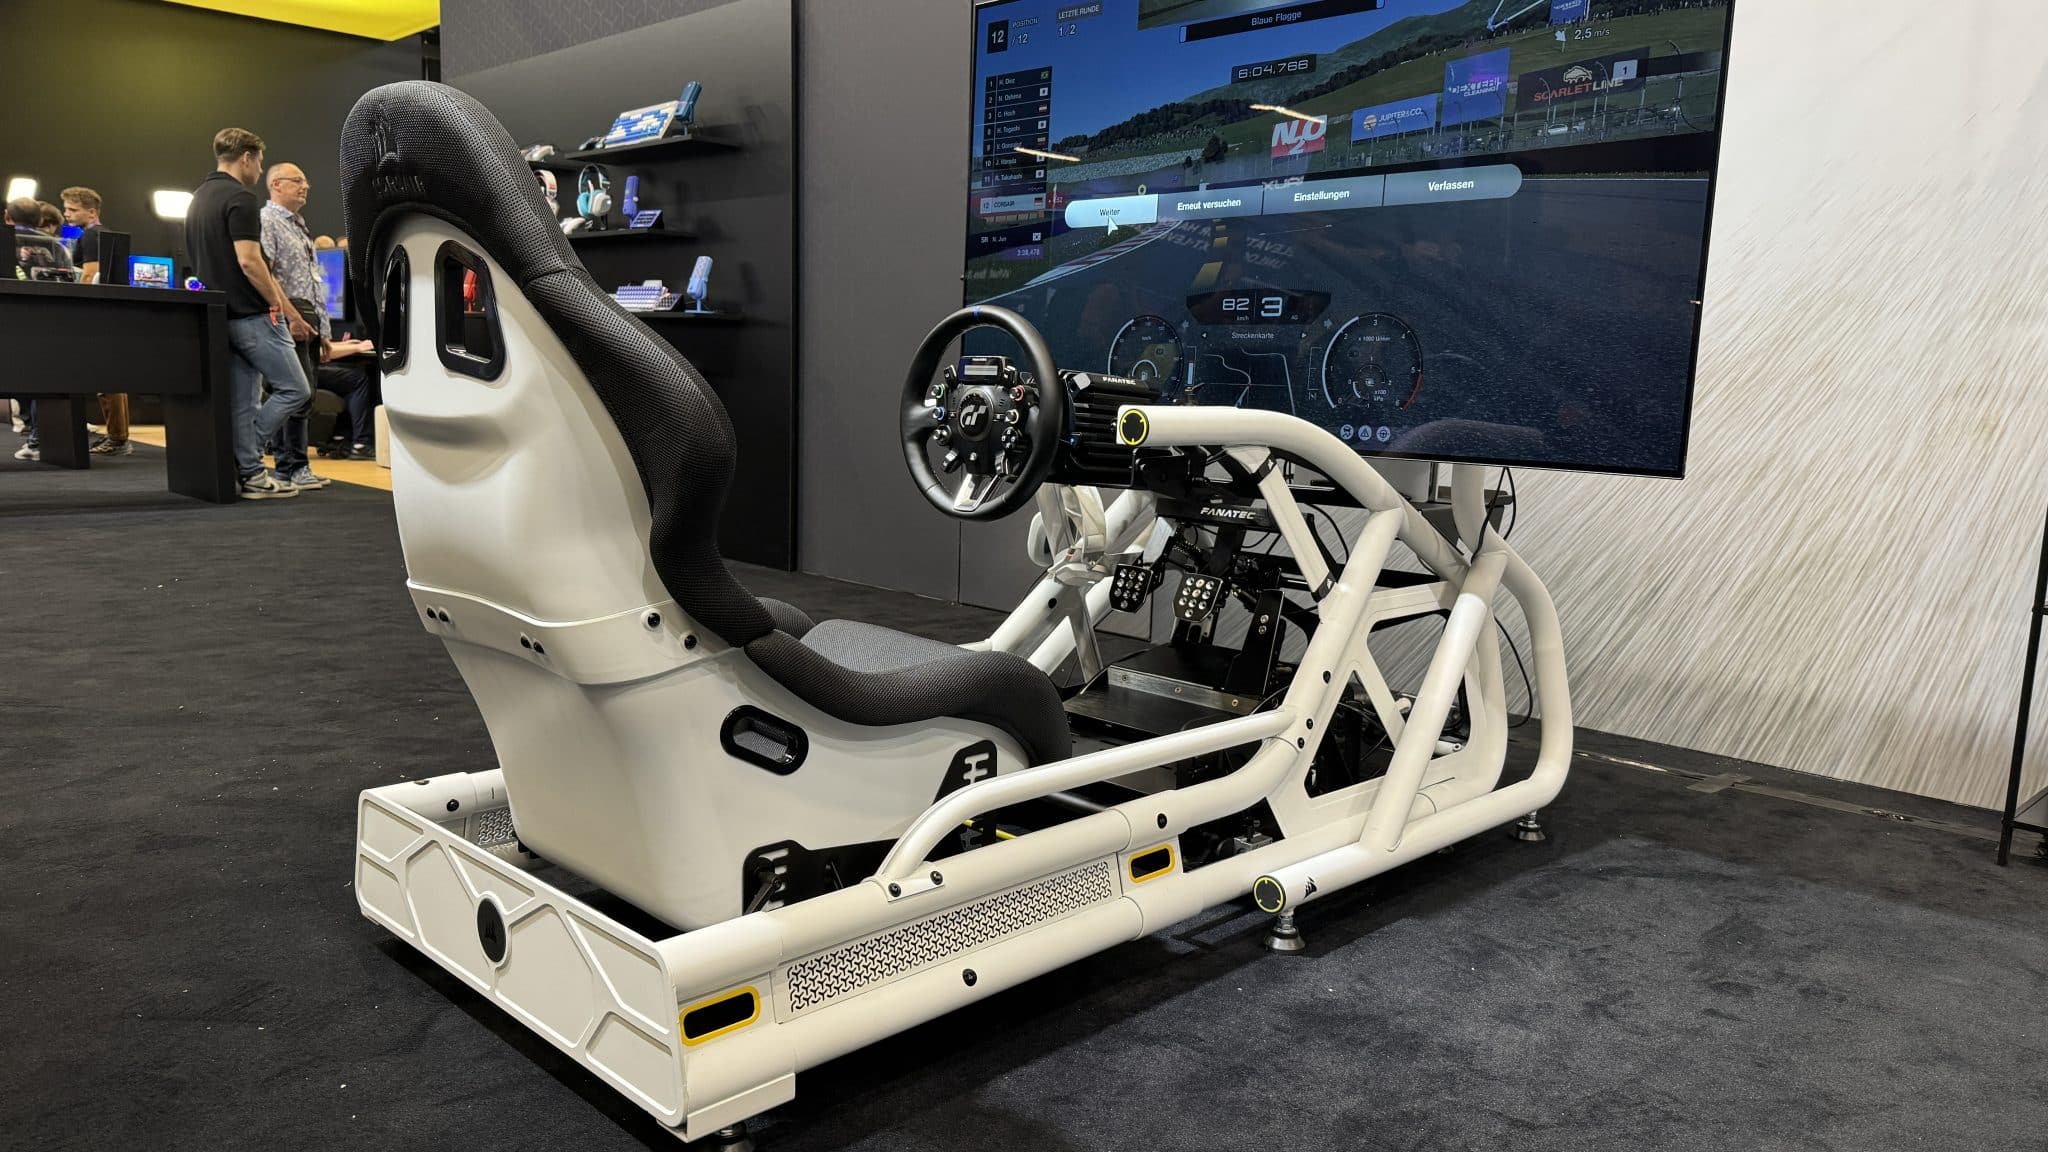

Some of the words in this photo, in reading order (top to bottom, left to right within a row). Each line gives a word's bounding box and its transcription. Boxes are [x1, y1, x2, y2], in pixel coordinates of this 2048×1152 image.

[1058, 8, 1079, 20] LETZTE
[1079, 4, 1100, 16] RUNDE
[1251, 16, 1273, 27] Blaue
[1275, 11, 1302, 25] Flagge
[1012, 17, 1039, 29] POSITION
[991, 30, 1005, 44] 12
[1574, 28, 1592, 41] 2,5
[1238, 59, 1309, 80] 6:04,766
[1428, 180, 1474, 191] Verlassen
[1294, 189, 1350, 203] Einstellungen
[1177, 201, 1202, 211] Erneut
[1203, 197, 1241, 210] versuchen
[1099, 206, 1120, 217] Weiter
[1222, 298, 1250, 311] 82
[1260, 296, 1284, 318] 3
[1231, 331, 1275, 340] Streckenkarte
[1199, 506, 1257, 520] FANATEC
